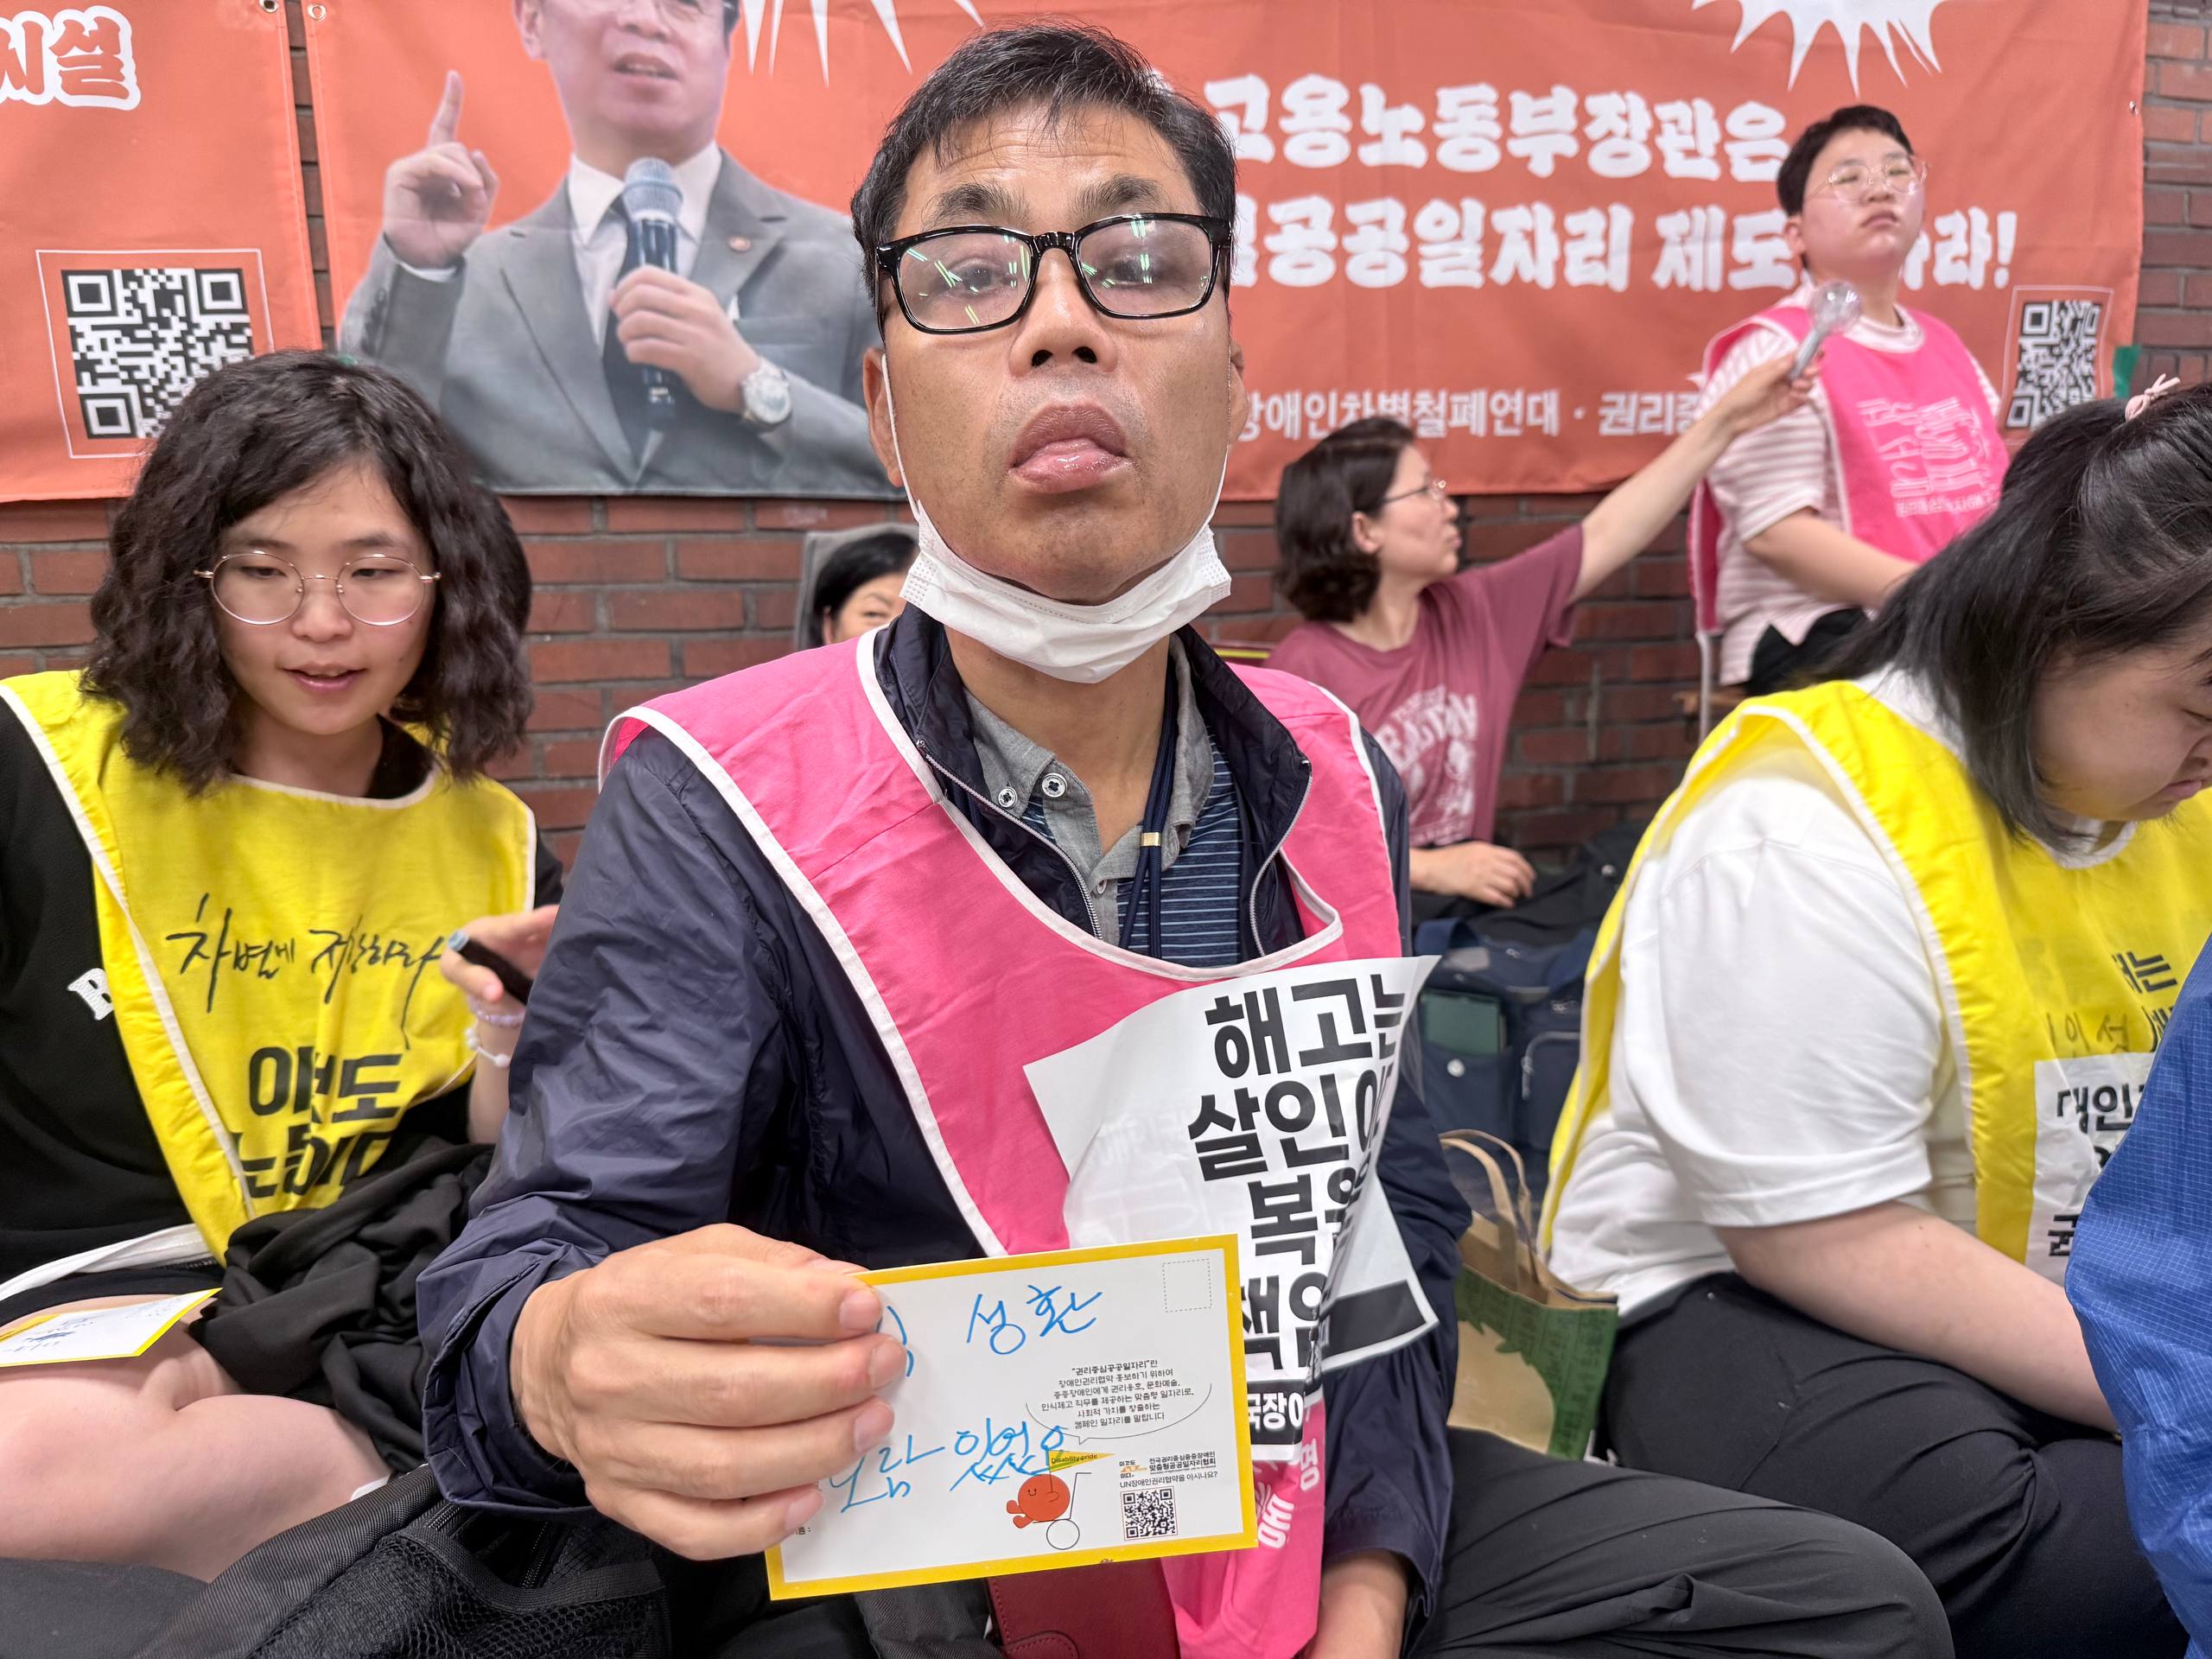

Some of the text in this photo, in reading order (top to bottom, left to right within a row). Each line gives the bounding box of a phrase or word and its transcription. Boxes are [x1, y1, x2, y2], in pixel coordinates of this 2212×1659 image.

[1203, 73, 1791, 181] 고용노동부장관은
[1230, 194, 1633, 292] 공공일자리
[1205, 974, 1406, 1080] 해고는
[1058, 1374, 1114, 1389] 장애인권리협약
[1149, 1368, 1173, 1379] 위하여
[1133, 1412, 1165, 1423] 말합니다
[1185, 1471, 1218, 1481] 아시나요?
